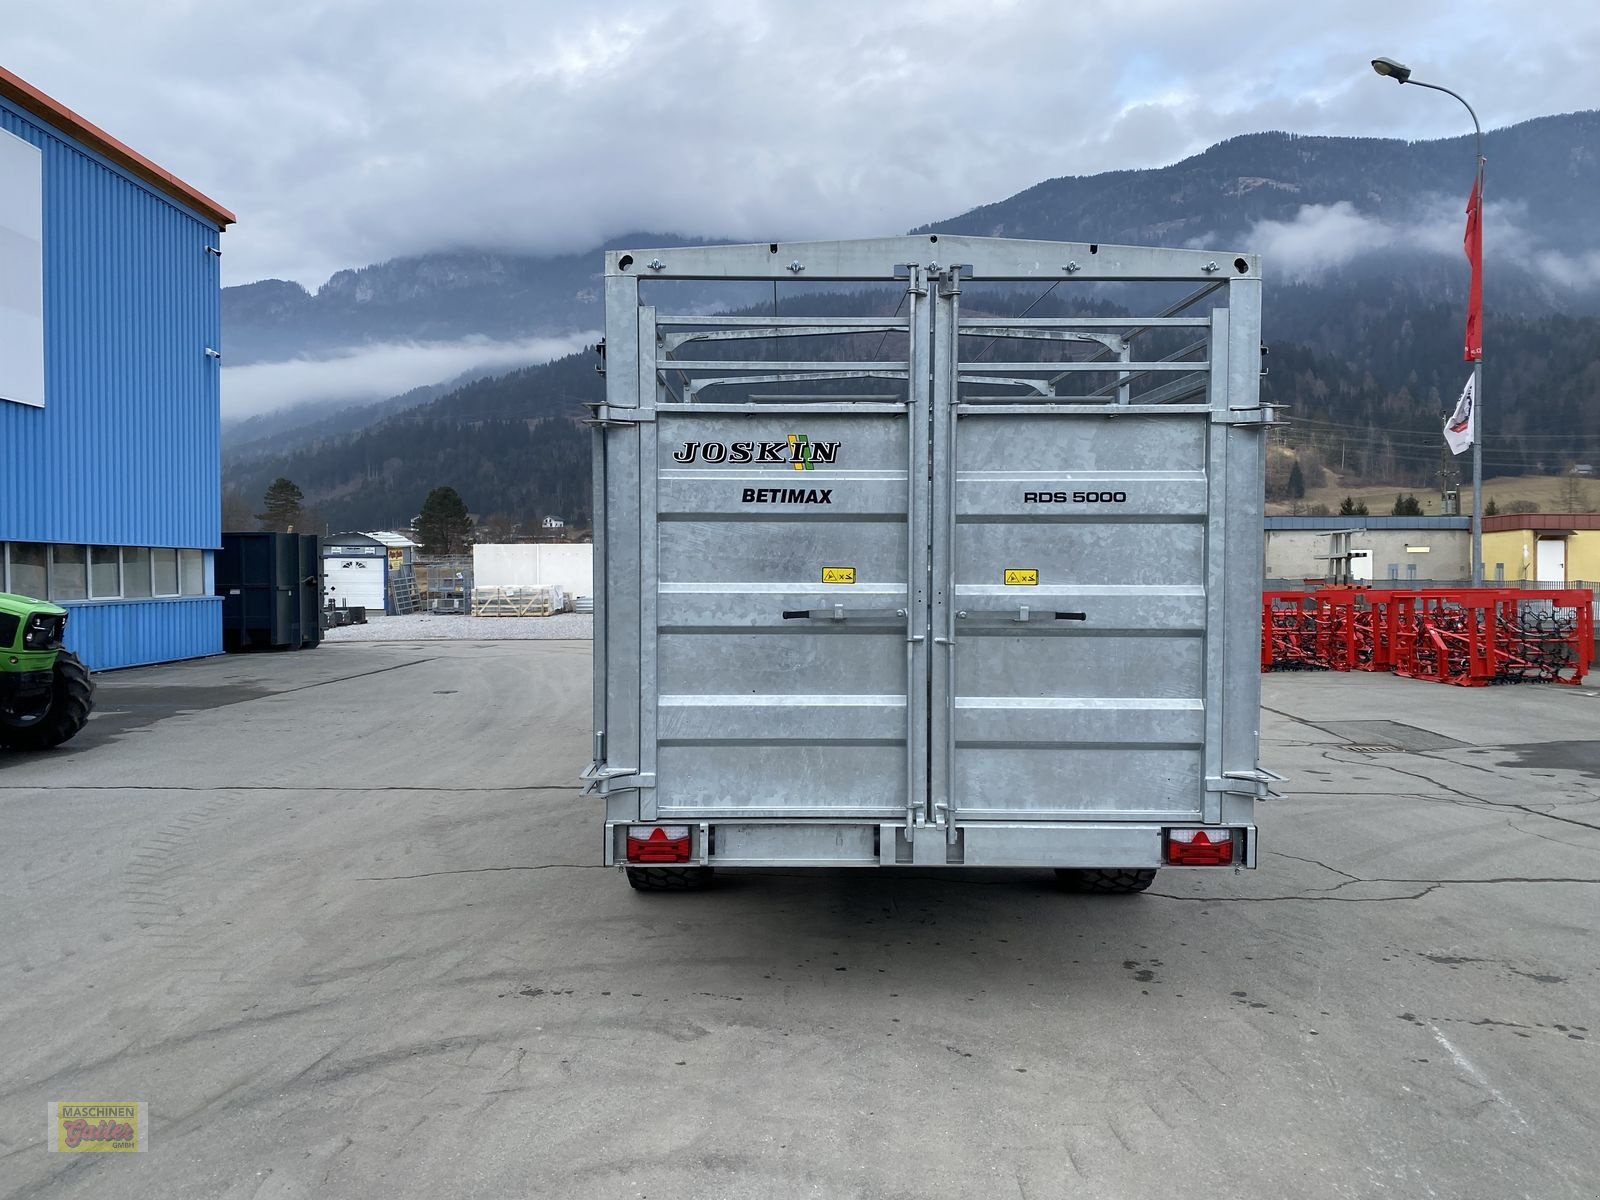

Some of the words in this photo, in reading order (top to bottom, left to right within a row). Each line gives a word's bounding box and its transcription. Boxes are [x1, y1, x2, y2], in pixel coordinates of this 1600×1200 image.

[673, 440, 841, 464] JOSKIN
[742, 488, 832, 504] BETIMAX
[1024, 492, 1067, 503] RDS
[1073, 492, 1127, 503] 5000
